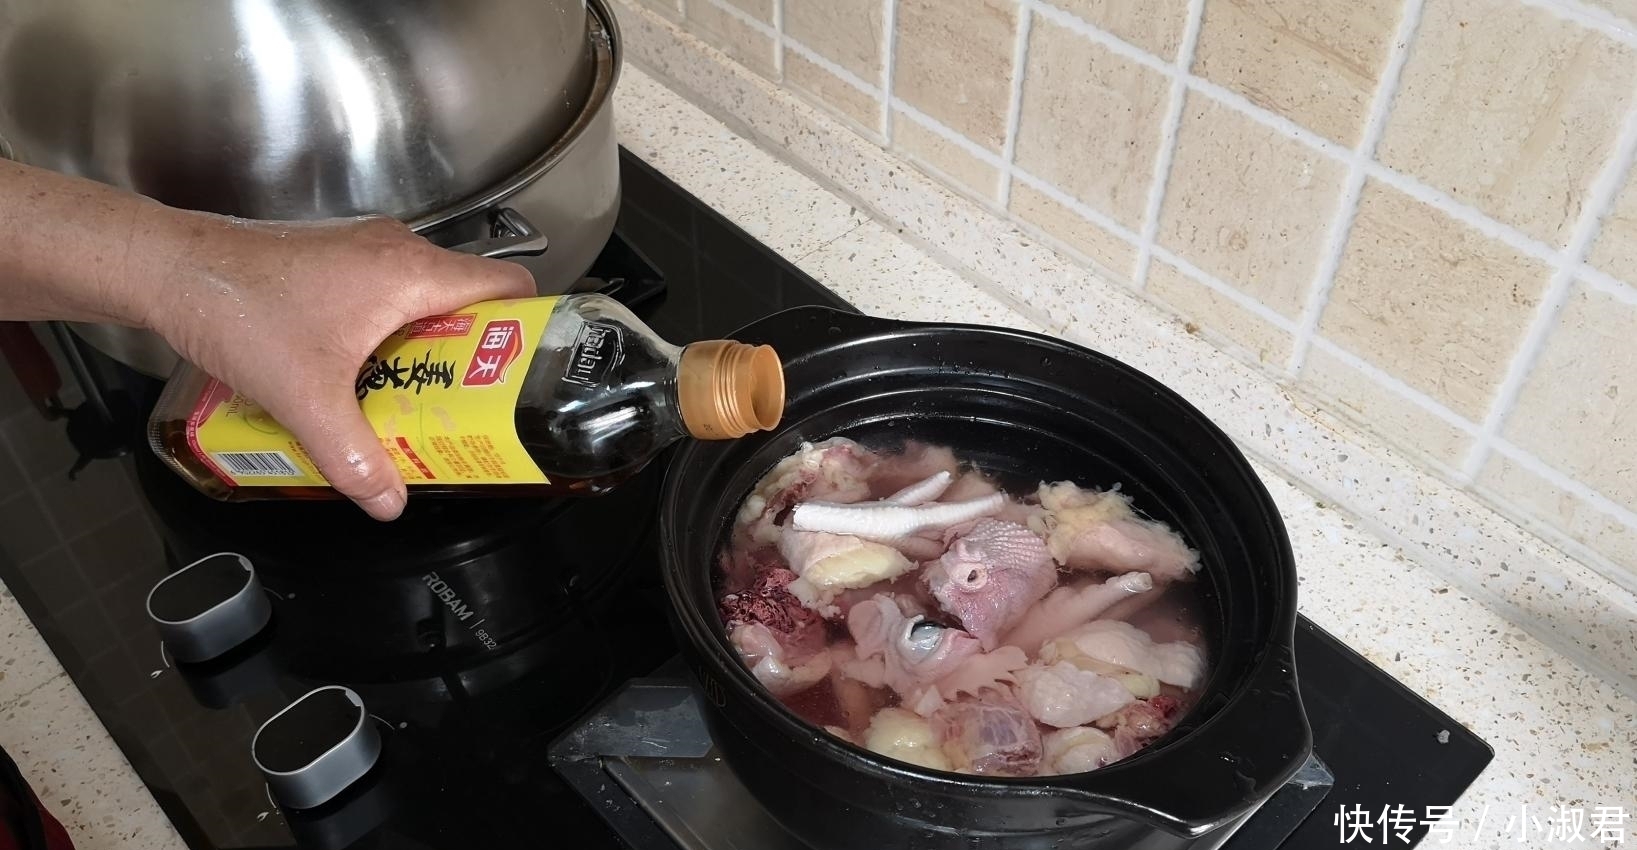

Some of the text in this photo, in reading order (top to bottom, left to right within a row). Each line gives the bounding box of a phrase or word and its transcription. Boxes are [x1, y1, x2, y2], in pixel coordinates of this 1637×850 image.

[468, 326, 515, 379] 海天
[421, 571, 497, 650] ROBAM 9B32
